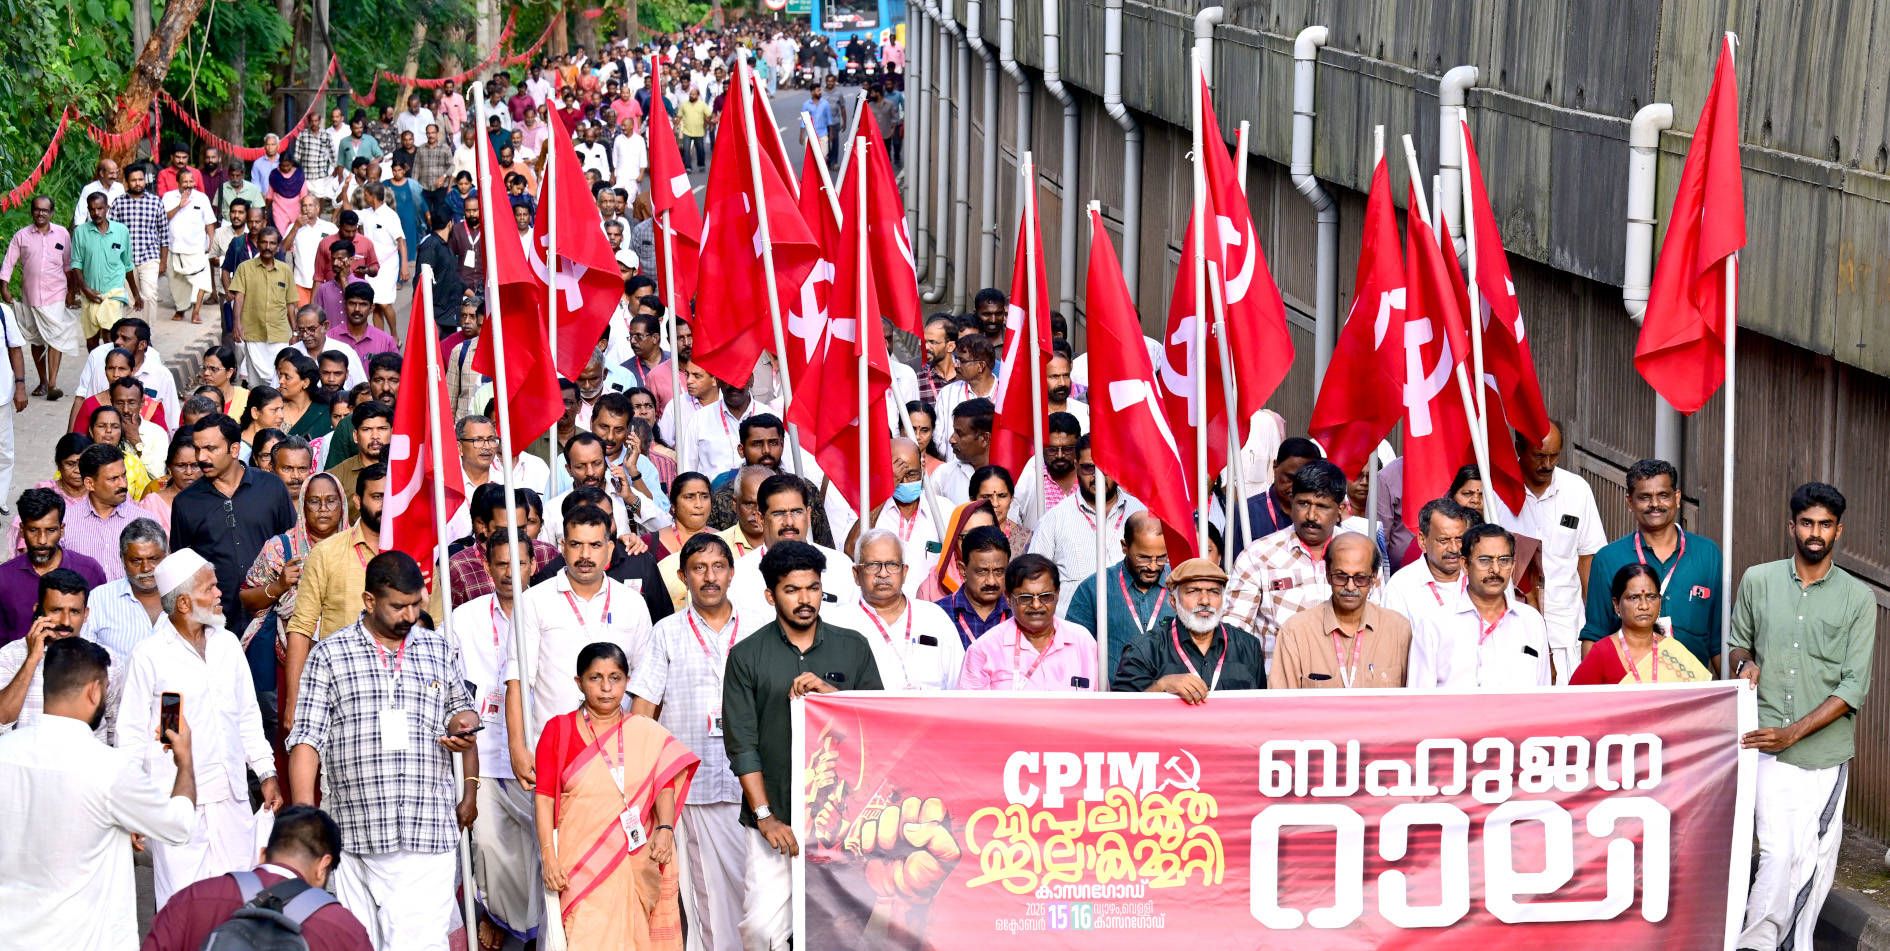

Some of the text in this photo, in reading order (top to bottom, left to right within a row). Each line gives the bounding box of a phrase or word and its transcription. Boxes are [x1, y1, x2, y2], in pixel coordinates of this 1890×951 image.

[1003, 750, 1160, 808] CPIM
[1258, 733, 1663, 803] ബഹുജന
[1249, 796, 1671, 930] റാലി
[1025, 902, 1046, 916] 2026
[1035, 879, 1149, 900] കാസറഗോഡ്
[1048, 904, 1092, 929] 15 16
